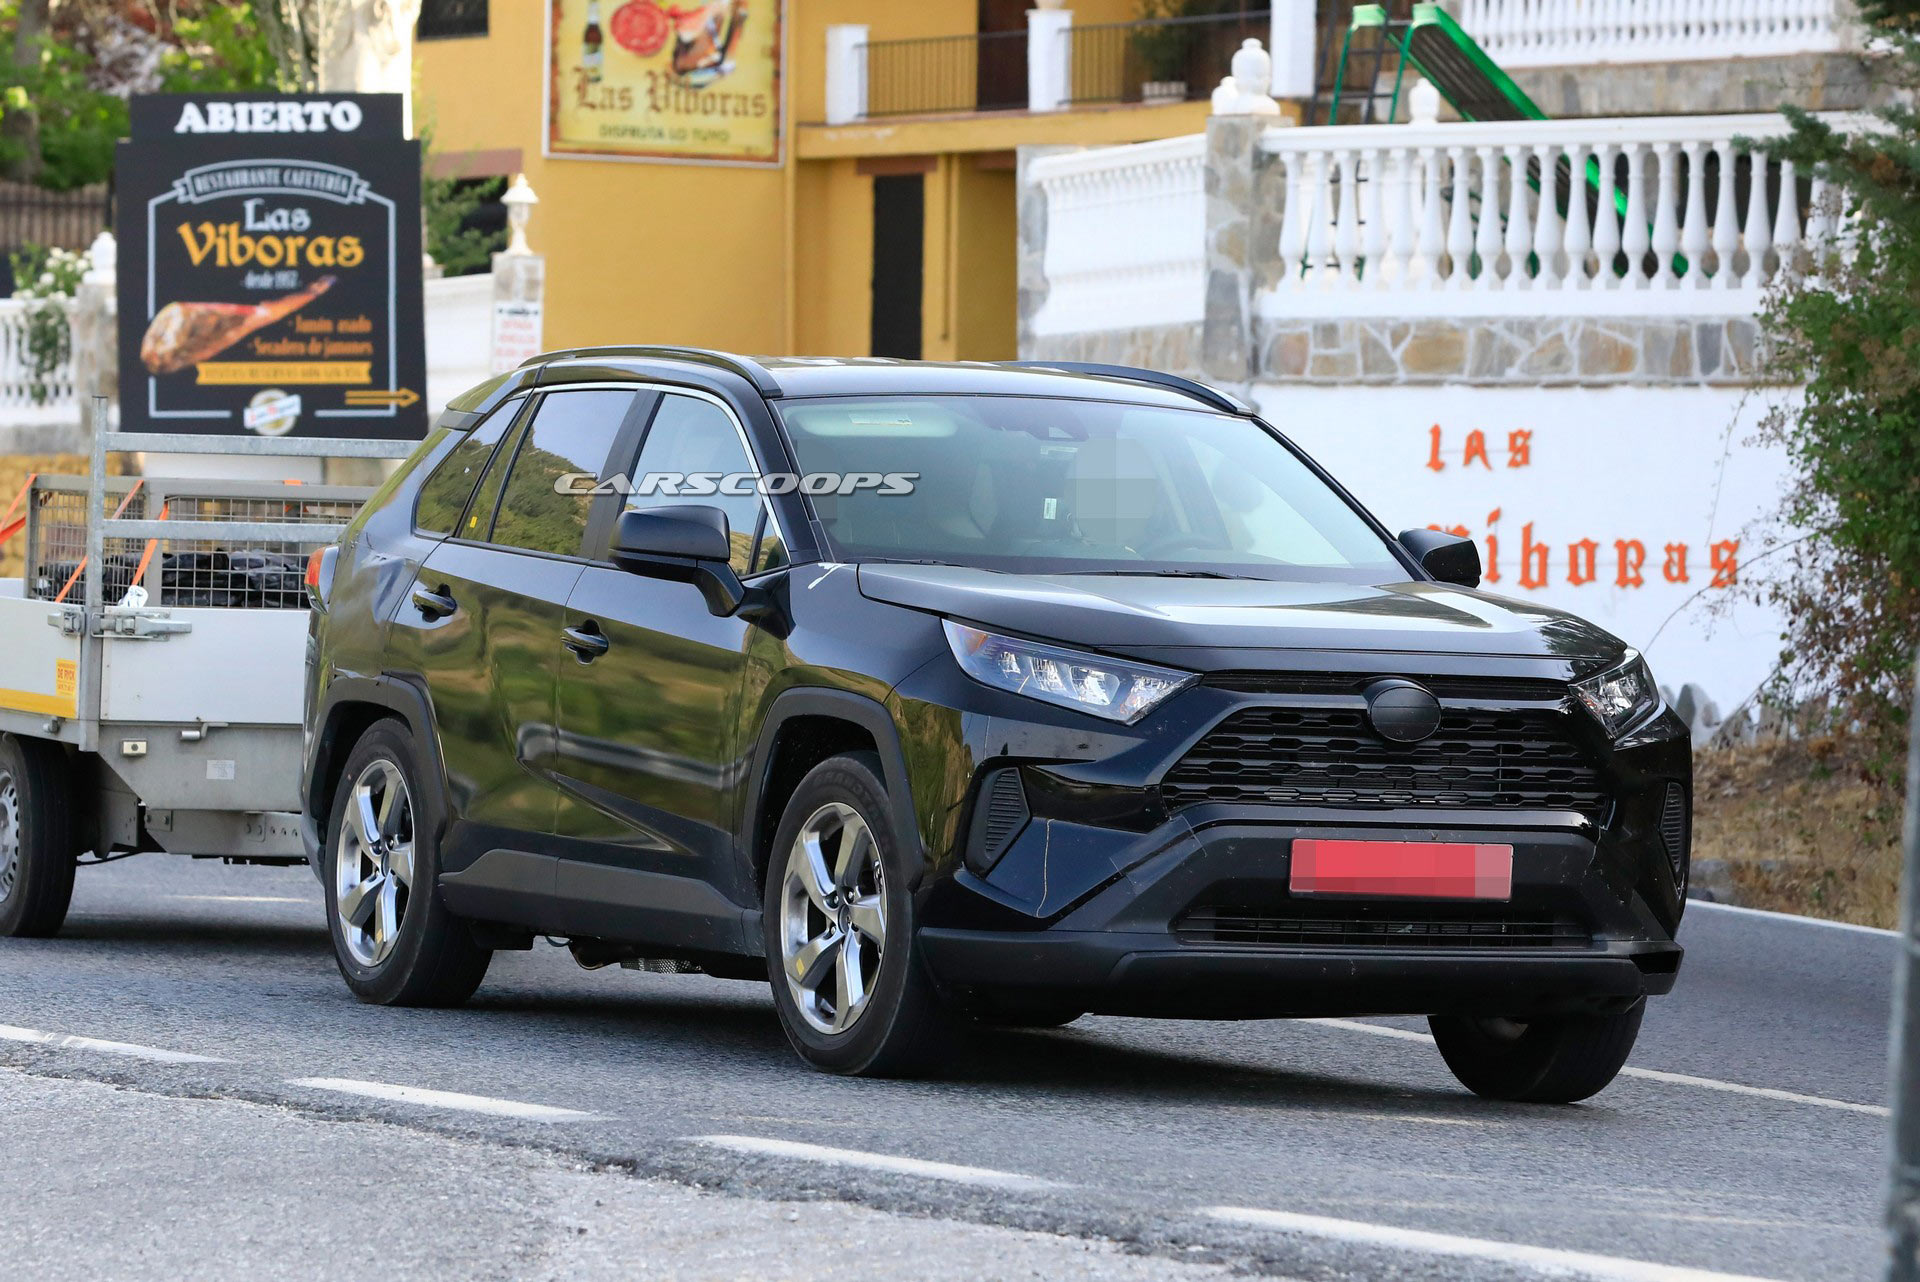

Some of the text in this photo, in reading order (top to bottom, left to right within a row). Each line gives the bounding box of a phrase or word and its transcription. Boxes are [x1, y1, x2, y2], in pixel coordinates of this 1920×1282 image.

[573, 66, 633, 112] Las
[174, 101, 363, 134] ABIERTO
[243, 197, 311, 232] Las
[176, 221, 365, 268] Viboras
